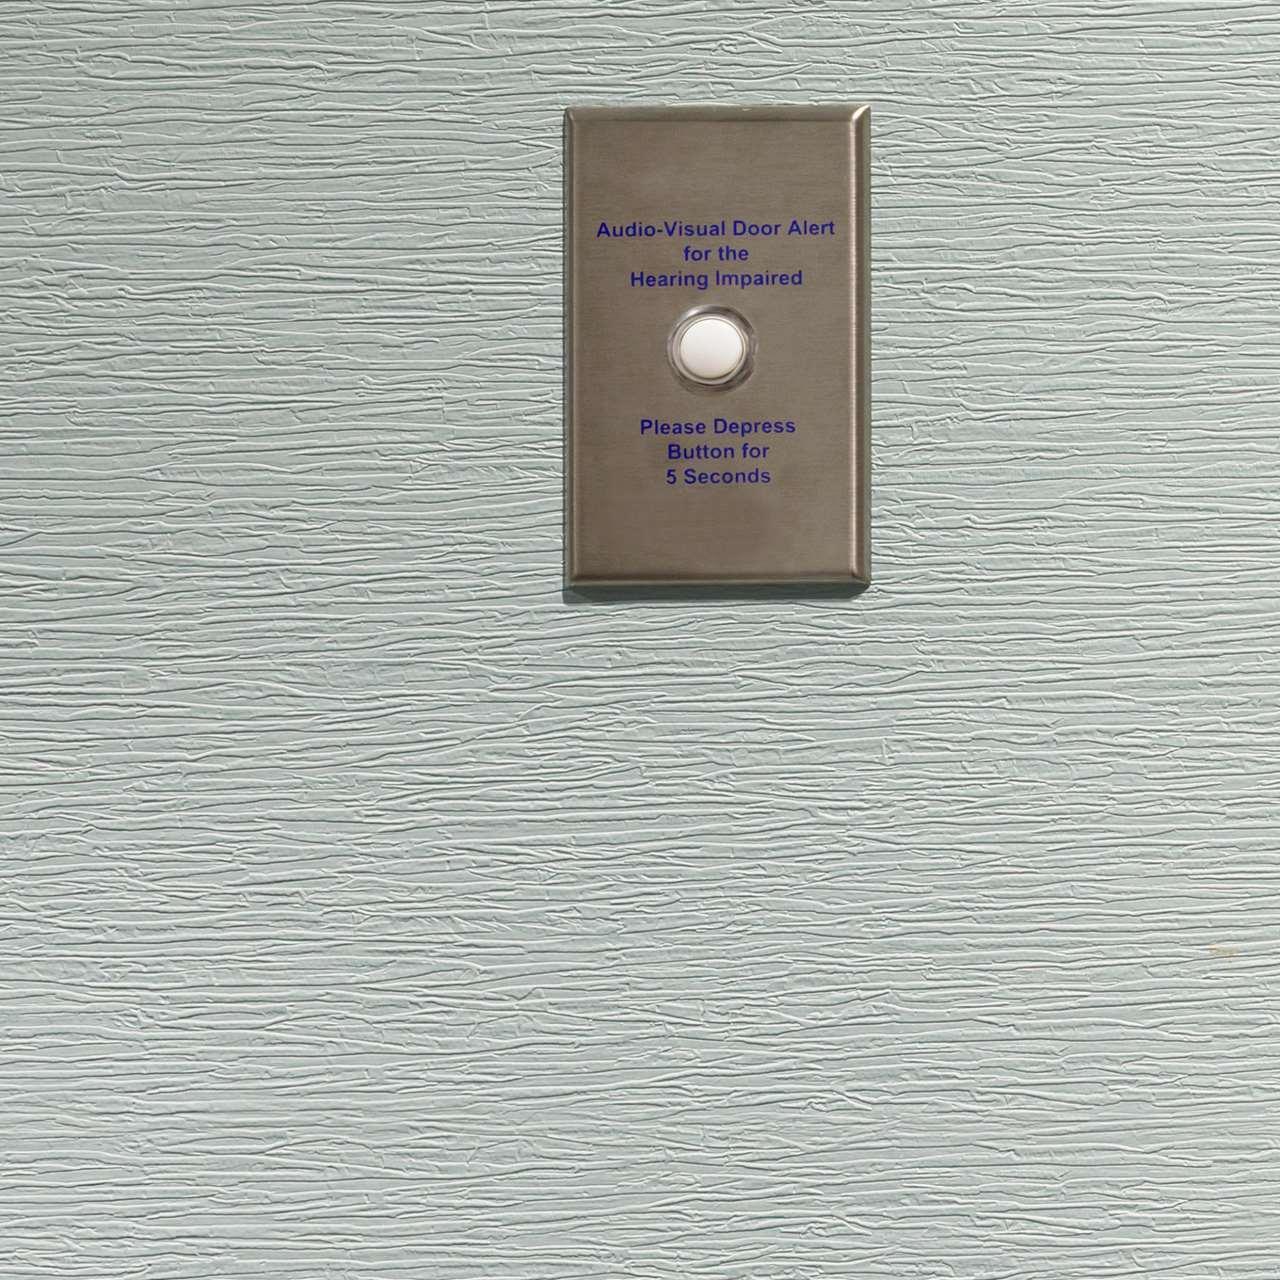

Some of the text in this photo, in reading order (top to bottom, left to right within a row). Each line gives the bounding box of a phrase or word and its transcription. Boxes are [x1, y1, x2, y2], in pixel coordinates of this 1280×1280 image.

[596, 219, 835, 238] Audio-Visual Door Alert
[683, 245, 749, 262] for the
[630, 269, 802, 291] Hearing Impaired
[640, 418, 796, 438] Please Depress
[667, 442, 770, 460] Button for
[666, 467, 771, 485] 5 Seconds
